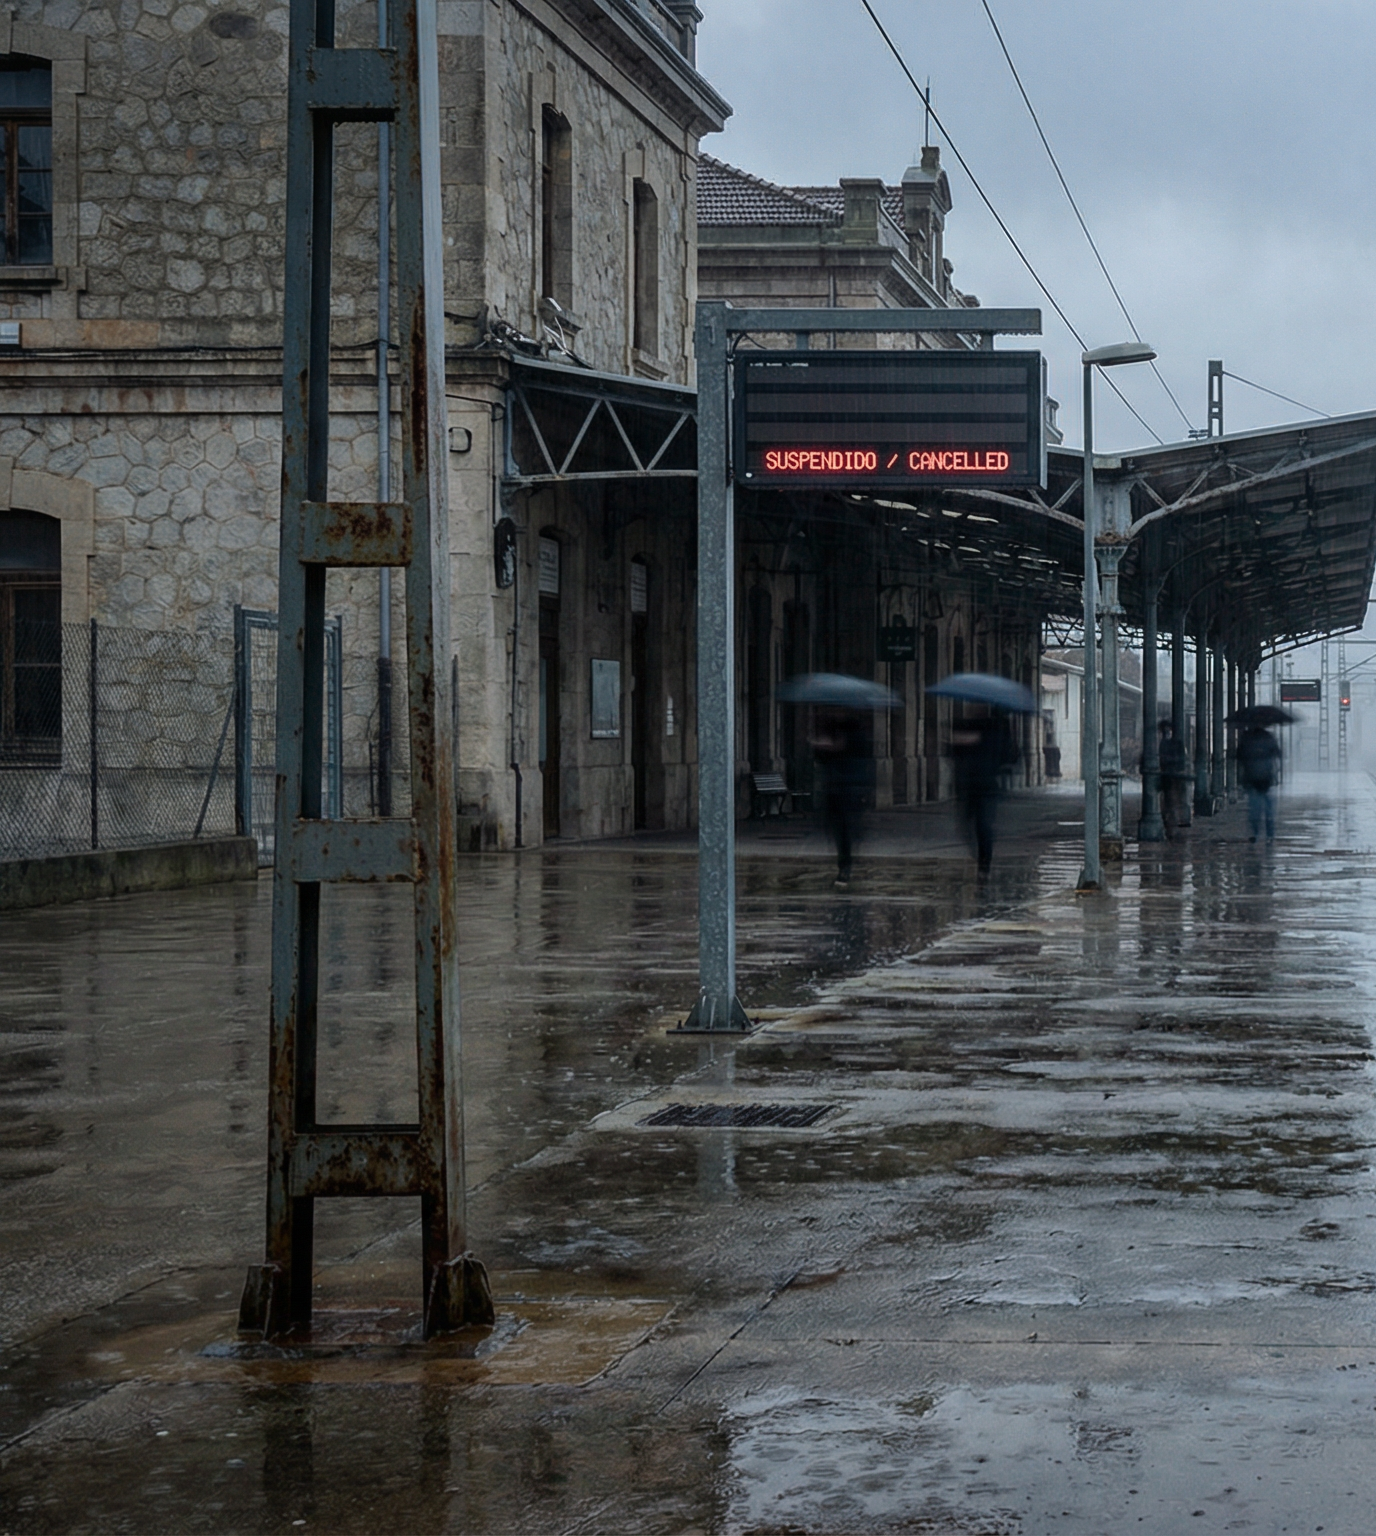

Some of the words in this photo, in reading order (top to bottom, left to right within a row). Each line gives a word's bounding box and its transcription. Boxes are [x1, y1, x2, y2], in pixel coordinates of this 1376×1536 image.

[765, 451, 877, 470] SUSPENDIDO
[886, 453, 898, 469] /
[909, 451, 1009, 471] CANCELLED
